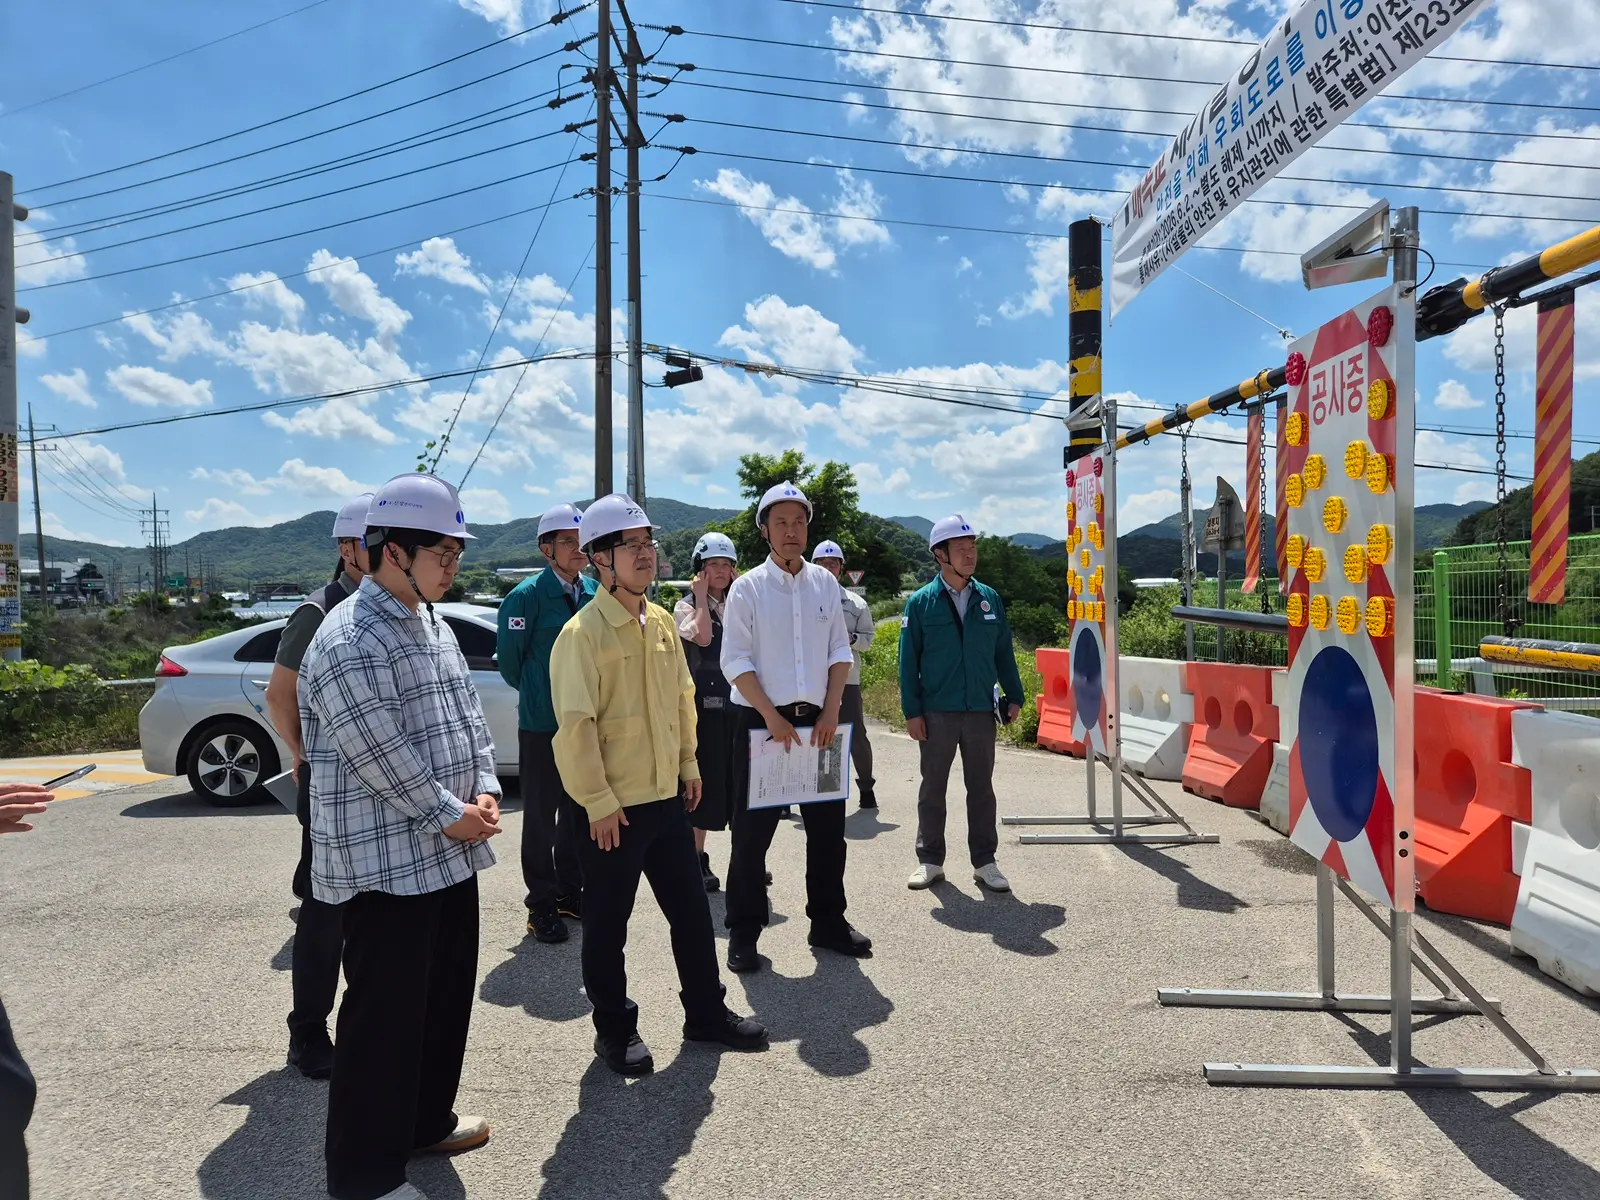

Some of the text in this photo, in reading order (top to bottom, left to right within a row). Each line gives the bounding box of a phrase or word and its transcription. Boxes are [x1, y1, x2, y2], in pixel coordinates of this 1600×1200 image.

[1156, 169, 1182, 222] 안전을
[1186, 134, 1209, 182] 위해
[1214, 30, 1305, 149] 우회도로를
[1193, 198, 1216, 228] 안전
[1213, 187, 1228, 211] 및
[1226, 130, 1293, 199] 유지관리에
[1289, 101, 1328, 144] 관한
[1324, 43, 1397, 112] 특별법]
[1220, 138, 1245, 174] 해제
[1246, 100, 1286, 150] 시까지
[1312, 352, 1364, 426] 공사중
[1076, 477, 1095, 511] 공사중
